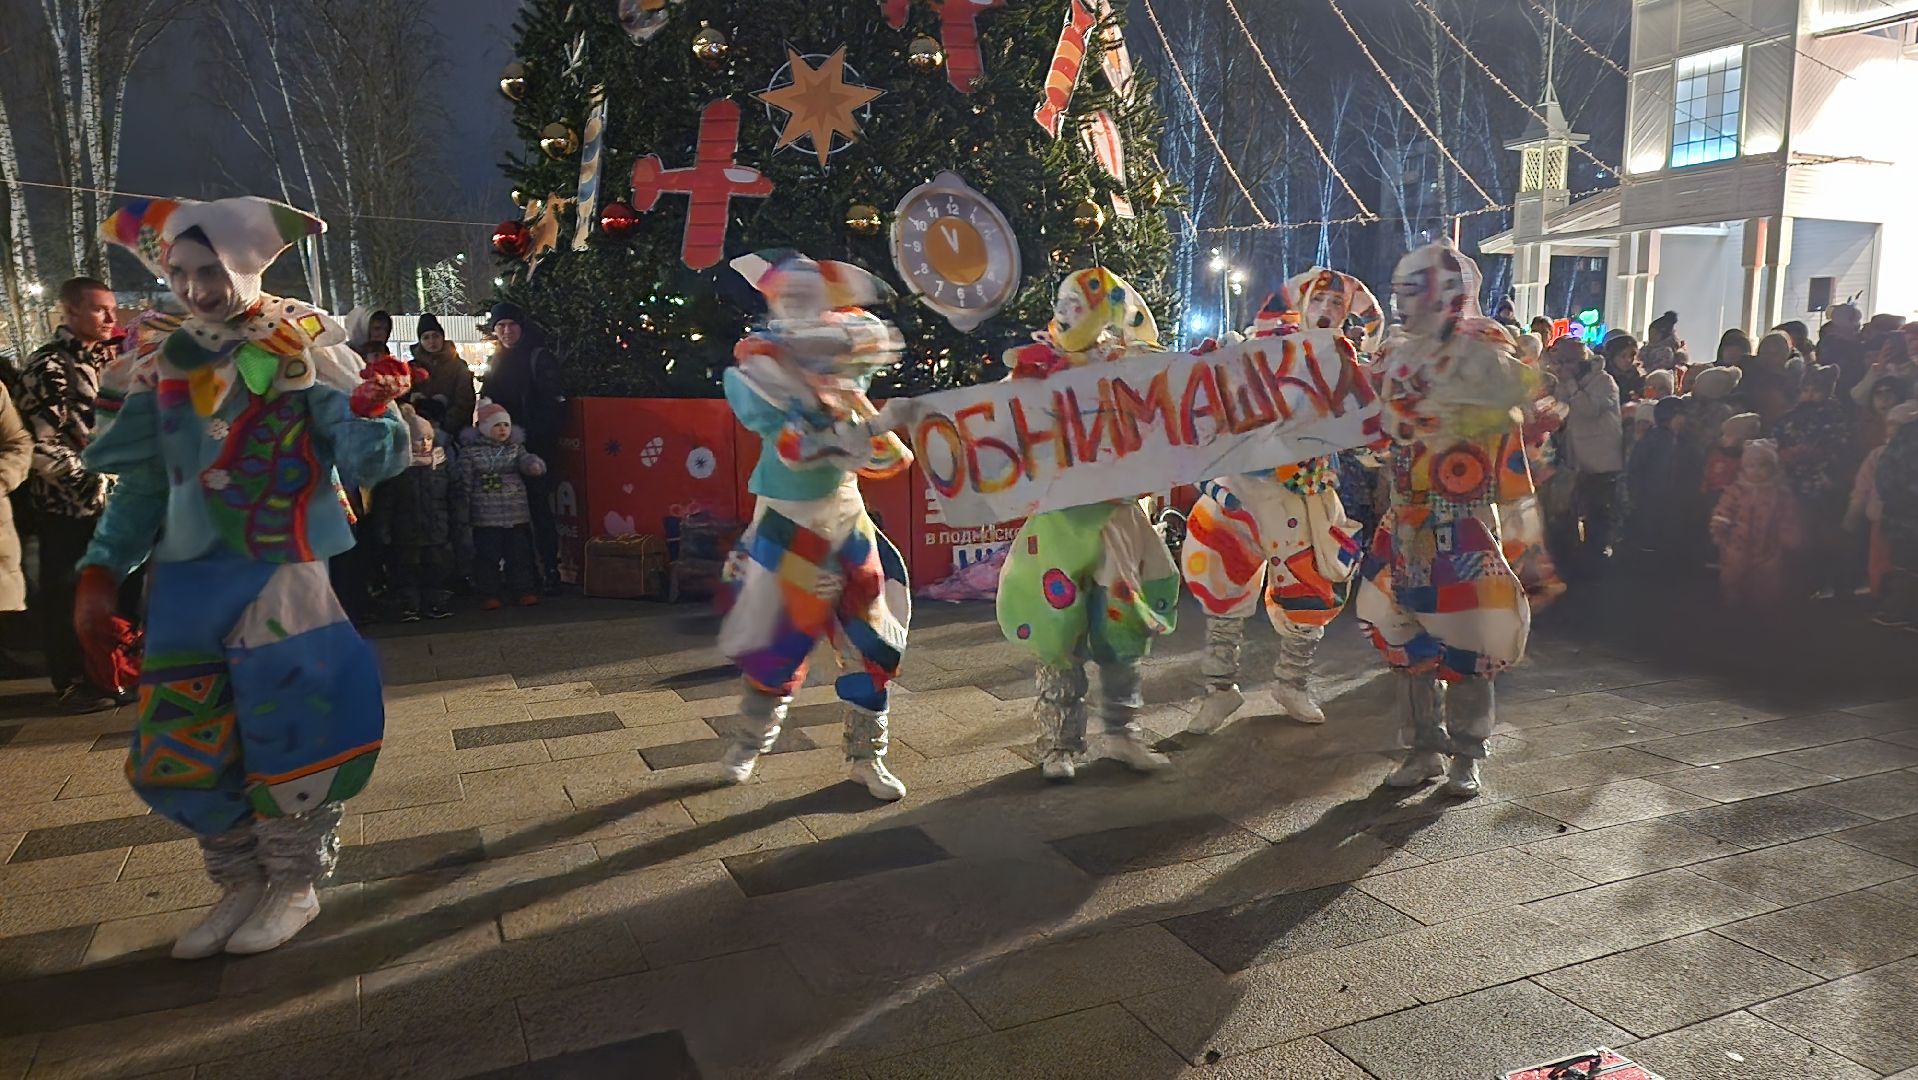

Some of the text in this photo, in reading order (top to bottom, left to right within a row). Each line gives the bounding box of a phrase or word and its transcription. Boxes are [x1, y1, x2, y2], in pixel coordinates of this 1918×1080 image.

[927, 206, 939, 218] 11
[946, 203, 960, 215] 12
[914, 220, 928, 231] 10
[913, 241, 922, 252] 9
[920, 263, 929, 274] 8
[935, 280, 944, 292] 7
[976, 285, 984, 296] 5
[957, 287, 966, 299] 6
[913, 334, 1377, 499] ОБНИМАШКИ
[925, 532, 936, 545] В
